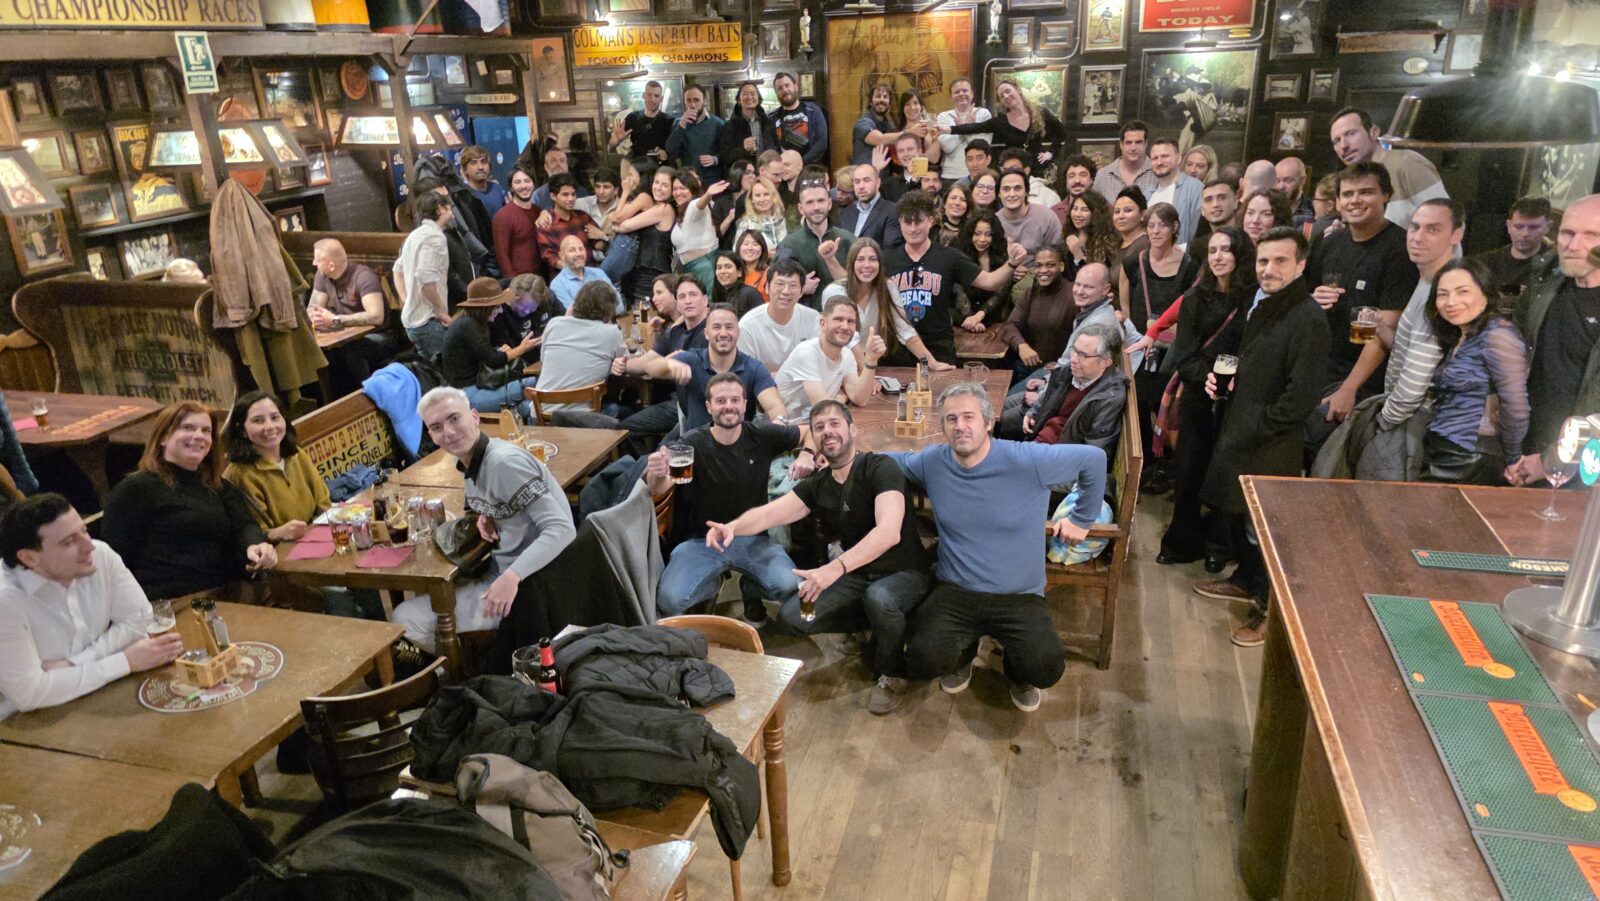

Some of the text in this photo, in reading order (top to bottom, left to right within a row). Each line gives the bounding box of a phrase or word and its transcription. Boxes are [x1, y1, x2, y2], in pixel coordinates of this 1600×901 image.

[12, 0, 257, 22] CHAMPIONSHIP RACES
[1157, 15, 1234, 26] TODAY
[639, 26, 669, 45] BASE
[708, 24, 740, 42] BATS
[588, 57, 609, 65] FOR
[662, 53, 729, 62] CHAMPIONS
[900, 290, 932, 306] BEACH
[117, 351, 201, 372] CHEVROLET
[304, 431, 346, 465] ORLD'S
[316, 439, 368, 475] SINCE
